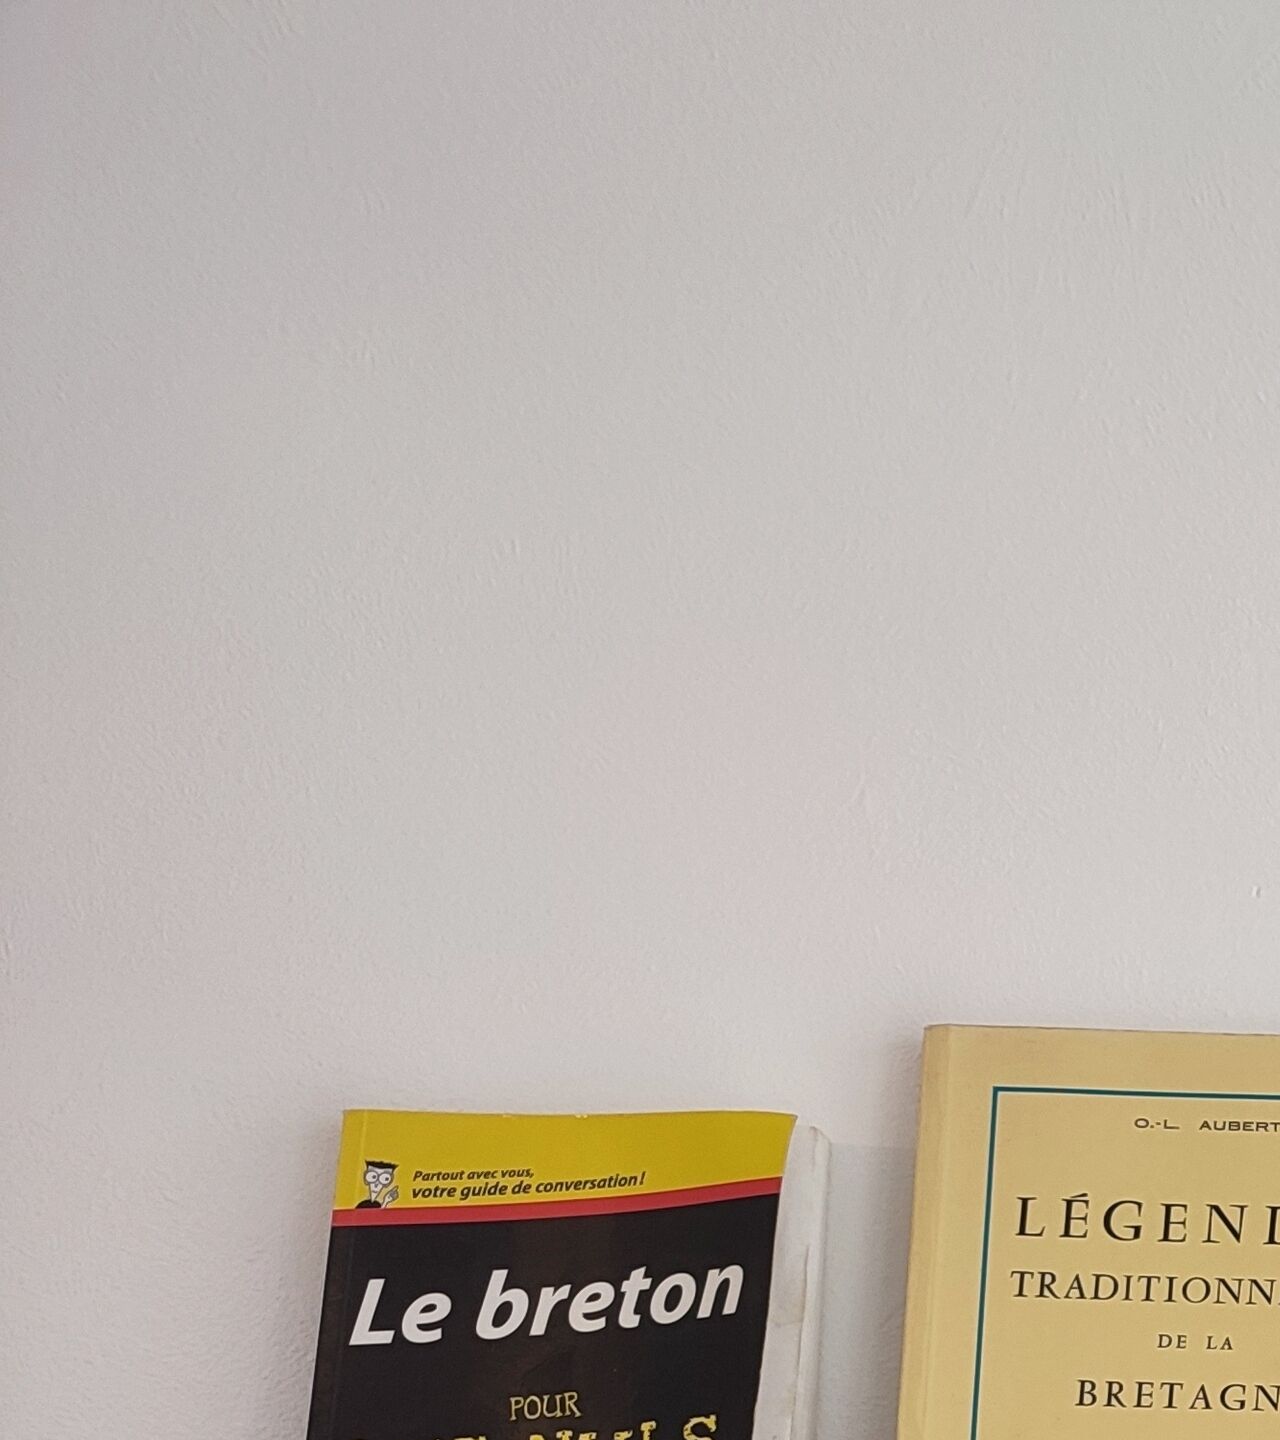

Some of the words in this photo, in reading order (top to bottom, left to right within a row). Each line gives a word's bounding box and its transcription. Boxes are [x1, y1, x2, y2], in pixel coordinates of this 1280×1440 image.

[413, 1170, 463, 1182] Partout
[467, 1170, 498, 1180] avec
[501, 1168, 535, 1179] vous,
[412, 1184, 457, 1199] votre
[460, 1181, 507, 1201] guide
[511, 1180, 532, 1195] de
[349, 1278, 452, 1346] Le
[475, 1263, 744, 1340] breton
[1157, 1333, 1188, 1349] DE
[1206, 1335, 1234, 1350] LA
[510, 1391, 581, 1420] POUR
